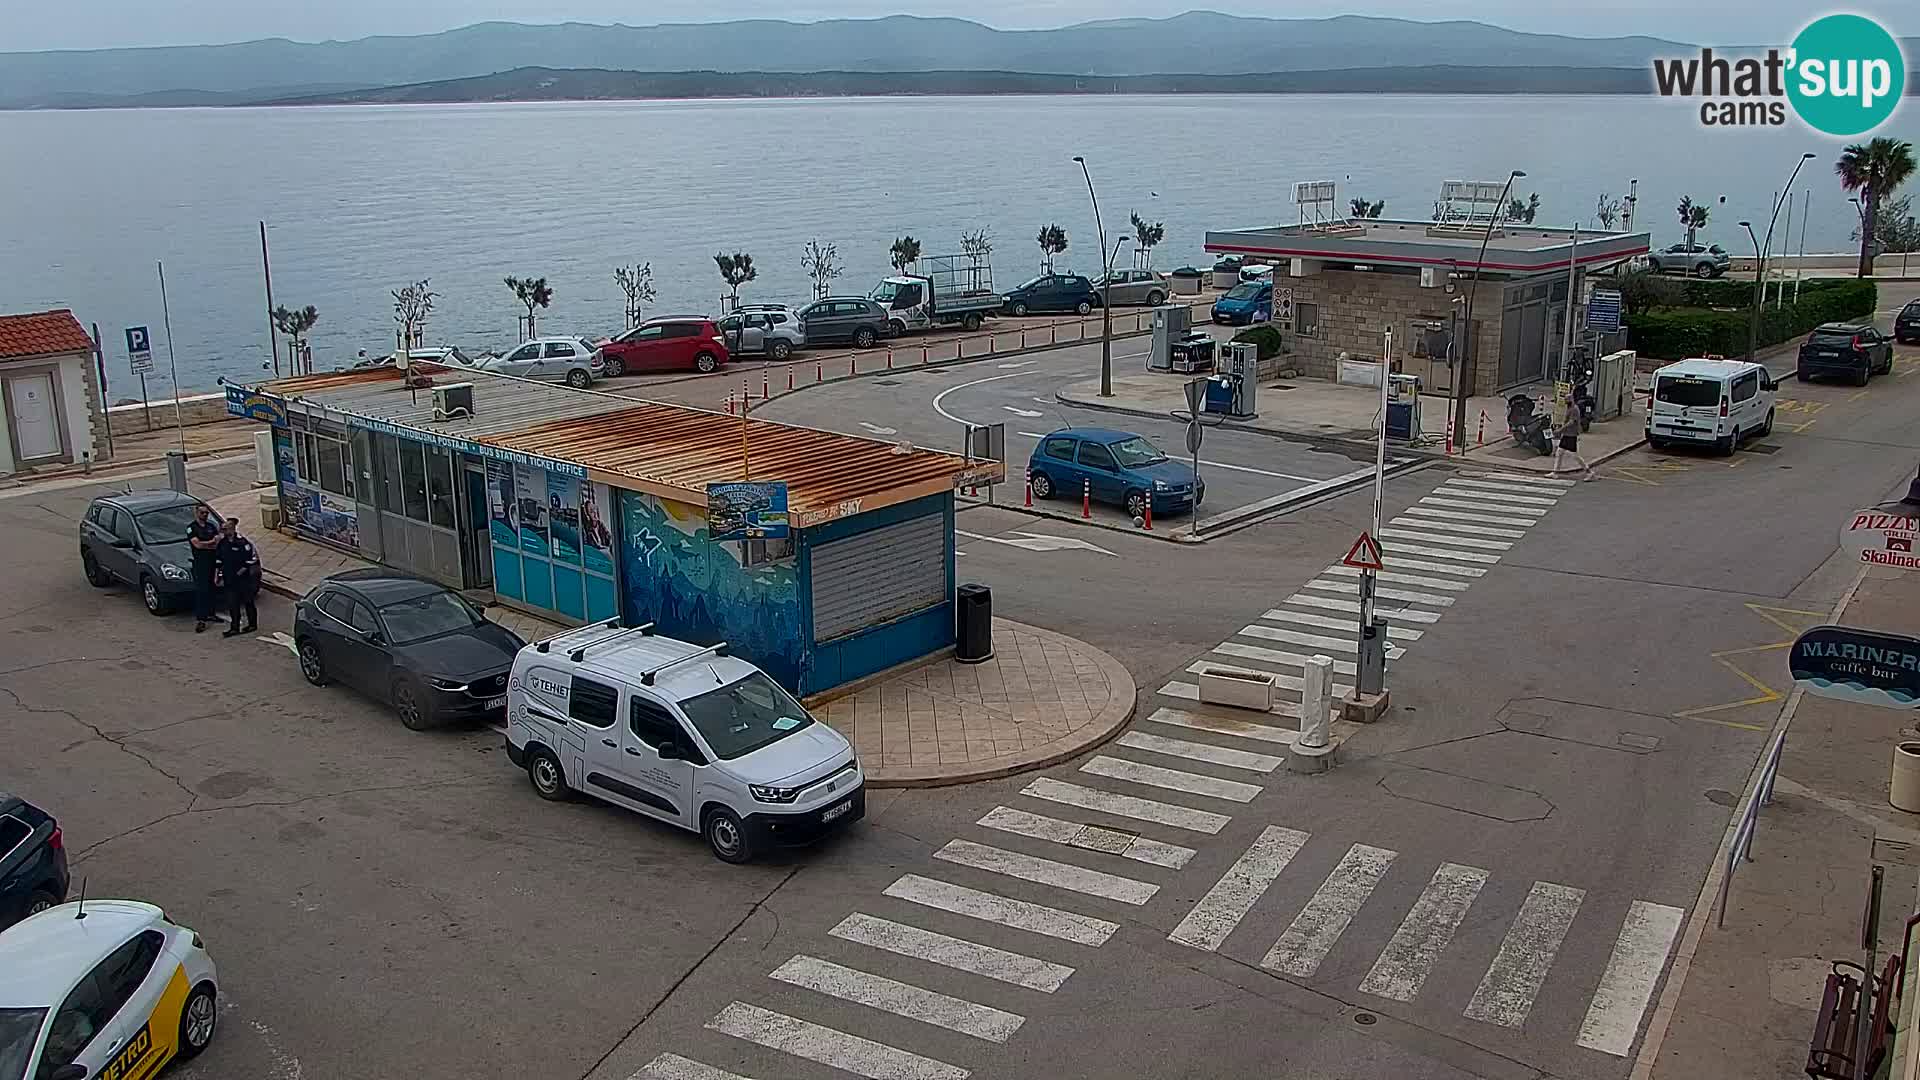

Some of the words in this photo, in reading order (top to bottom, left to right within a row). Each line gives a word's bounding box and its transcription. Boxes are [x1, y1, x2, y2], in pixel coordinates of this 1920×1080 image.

[131, 330, 144, 349] P
[348, 415, 373, 429] PRODAJA
[397, 427, 437, 444] AUTOBUSNA
[438, 435, 469, 451] POSTAJA
[479, 446, 494, 457] BUS
[495, 450, 527, 464] STATION
[529, 457, 554, 470] TICKET
[556, 463, 584, 476] OFFICE
[1848, 513, 1920, 532] PIZZE
[1883, 529, 1919, 540] GRILL
[1802, 642, 1920, 672] MARINER
[1830, 661, 1867, 675] caffe
[1871, 665, 1899, 680] bar
